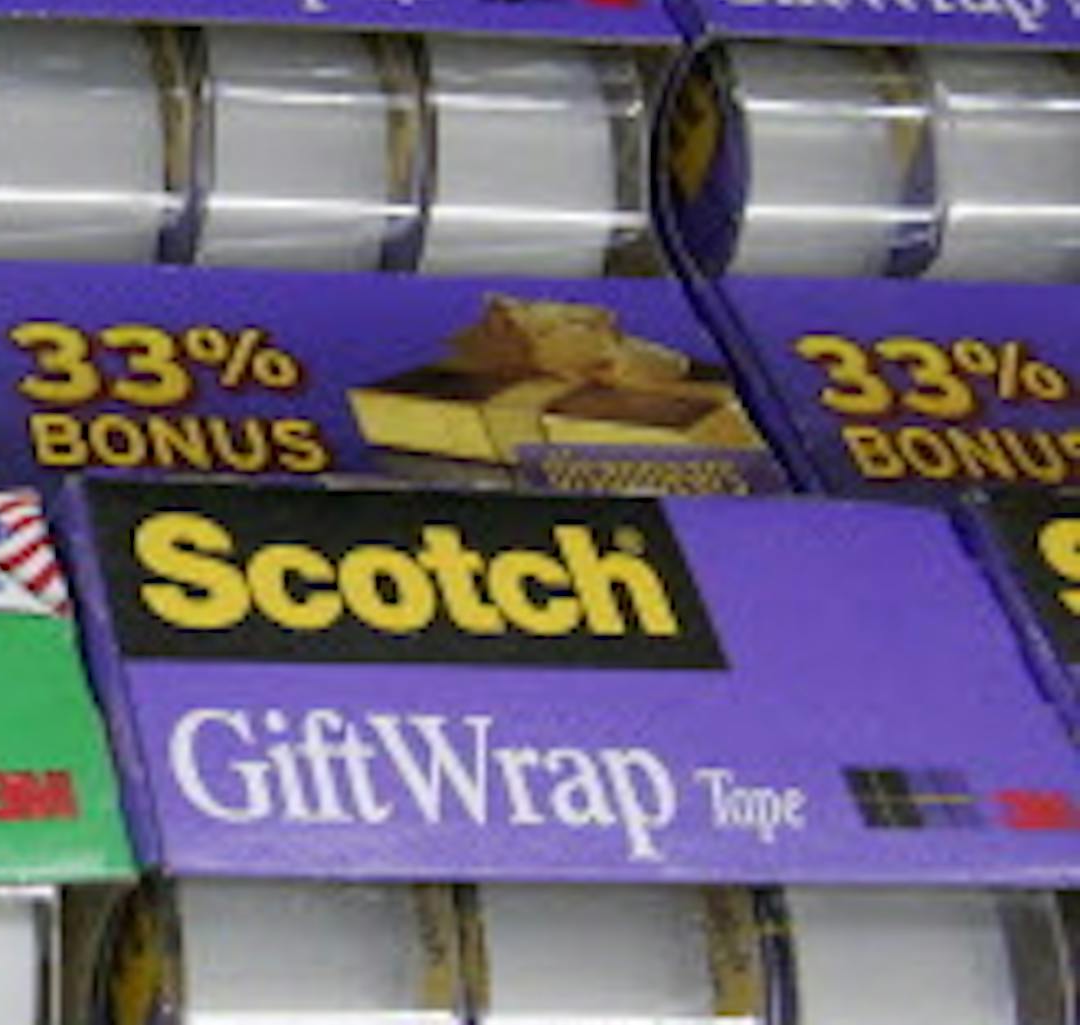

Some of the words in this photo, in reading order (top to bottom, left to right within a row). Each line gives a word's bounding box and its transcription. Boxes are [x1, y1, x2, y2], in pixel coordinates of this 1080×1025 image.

[9, 321, 297, 404] 33%
[795, 336, 1069, 419] 33%
[31, 414, 330, 471] BONUS
[135, 513, 679, 635] Scotch
[170, 708, 677, 862] GiftWrap
[694, 769, 805, 843] Tape
